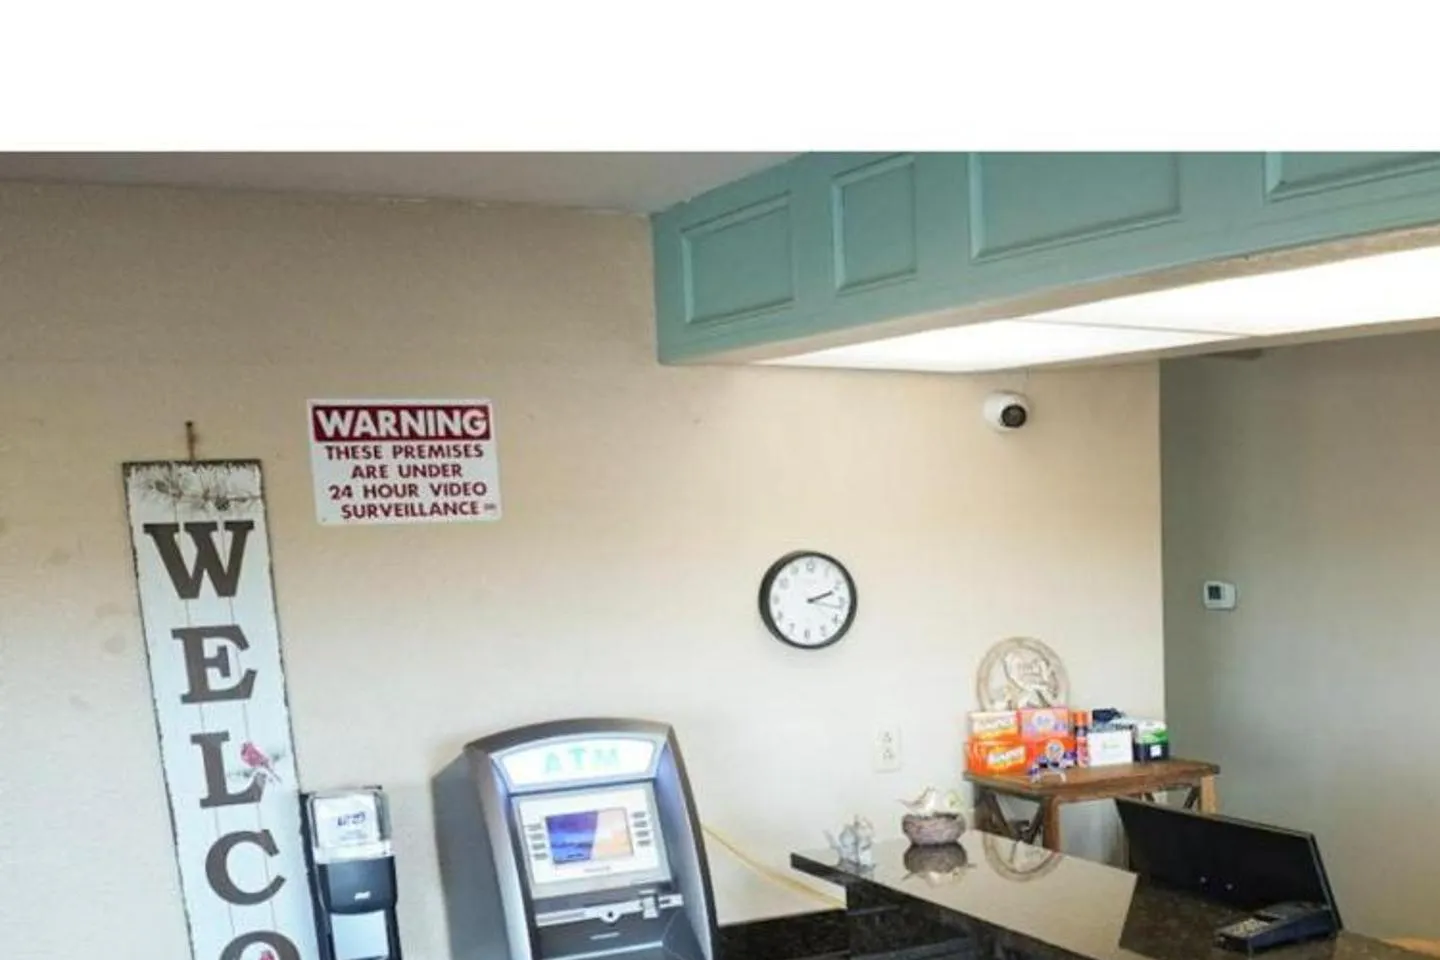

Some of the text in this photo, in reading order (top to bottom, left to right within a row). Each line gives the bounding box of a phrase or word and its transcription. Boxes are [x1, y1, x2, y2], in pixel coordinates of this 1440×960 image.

[315, 409, 488, 438] WARNING
[325, 443, 484, 460] THESE PREMISES
[351, 463, 463, 479] ARE UNDER
[328, 482, 488, 500] 24 HOUR VIDEO
[341, 501, 479, 519] SURVEILLANCE
[544, 747, 620, 773] ATM
